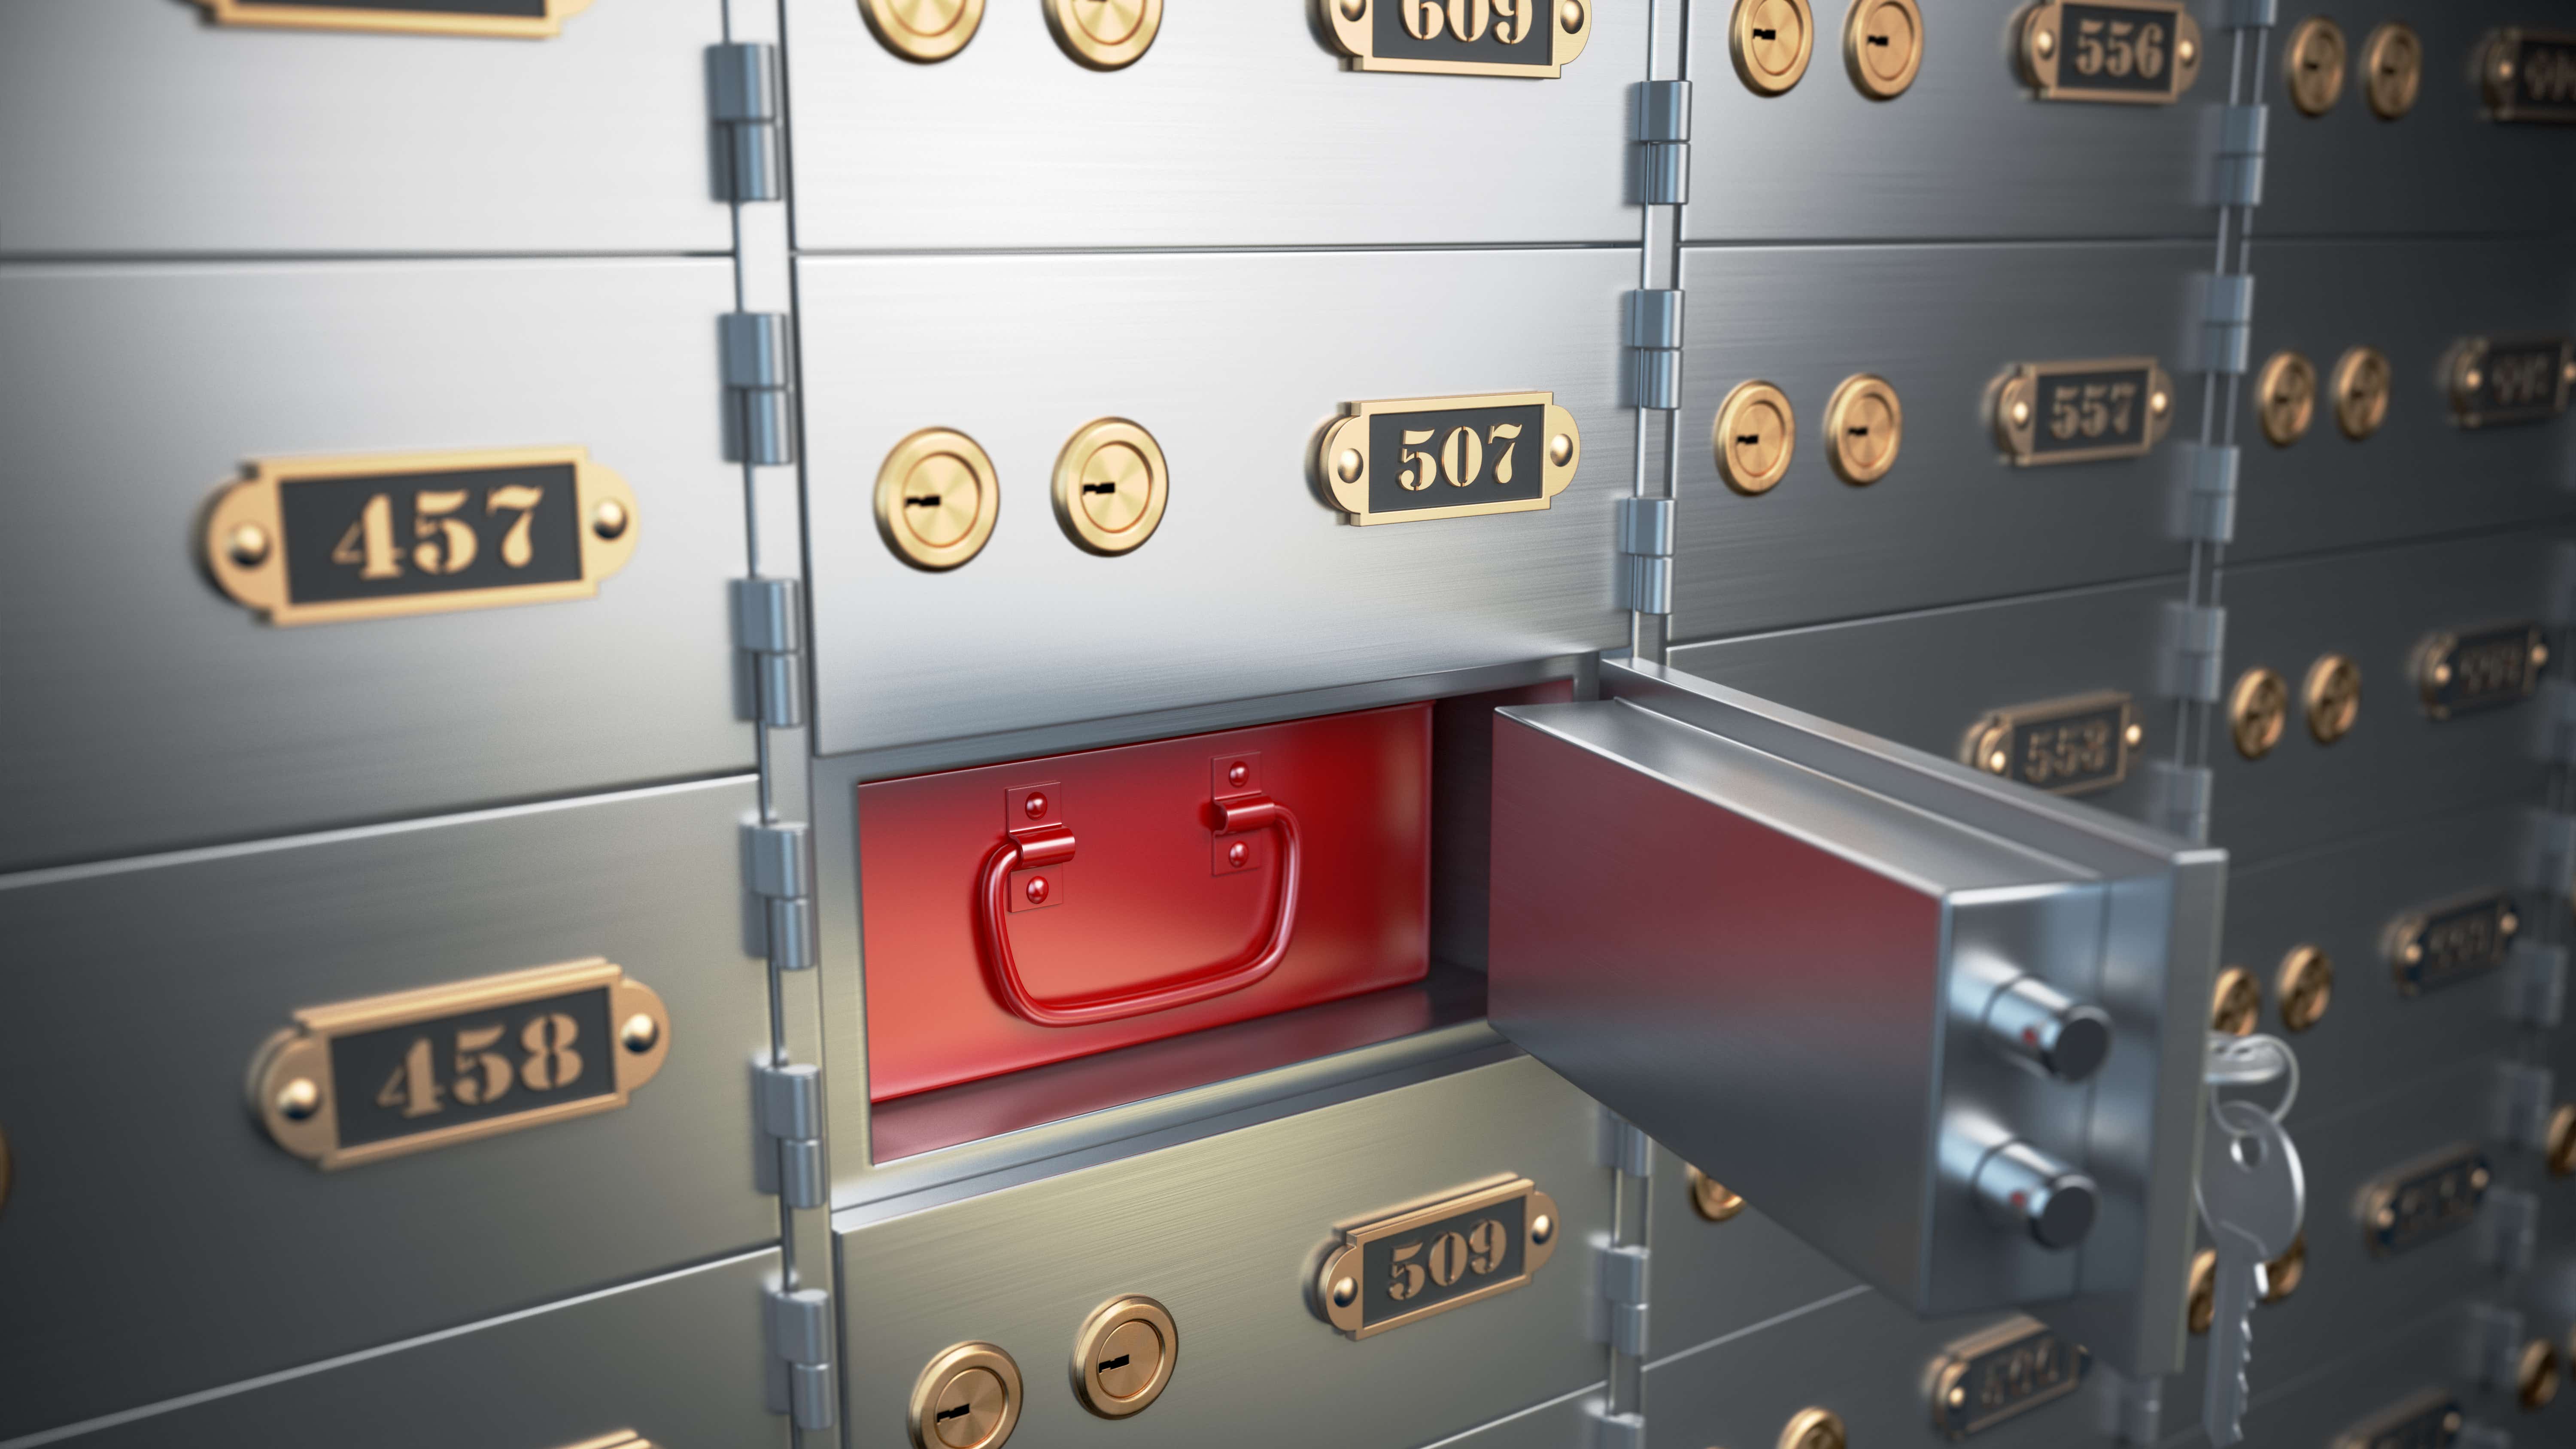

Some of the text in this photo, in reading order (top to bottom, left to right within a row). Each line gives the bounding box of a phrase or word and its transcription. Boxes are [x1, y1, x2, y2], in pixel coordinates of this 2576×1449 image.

[2076, 20, 2164, 79] 556
[2050, 382, 2137, 440] 557
[1399, 423, 1522, 491] 507
[331, 485, 543, 581] 457
[375, 1012, 584, 1118] 458
[1388, 1218, 1507, 1301] 509
